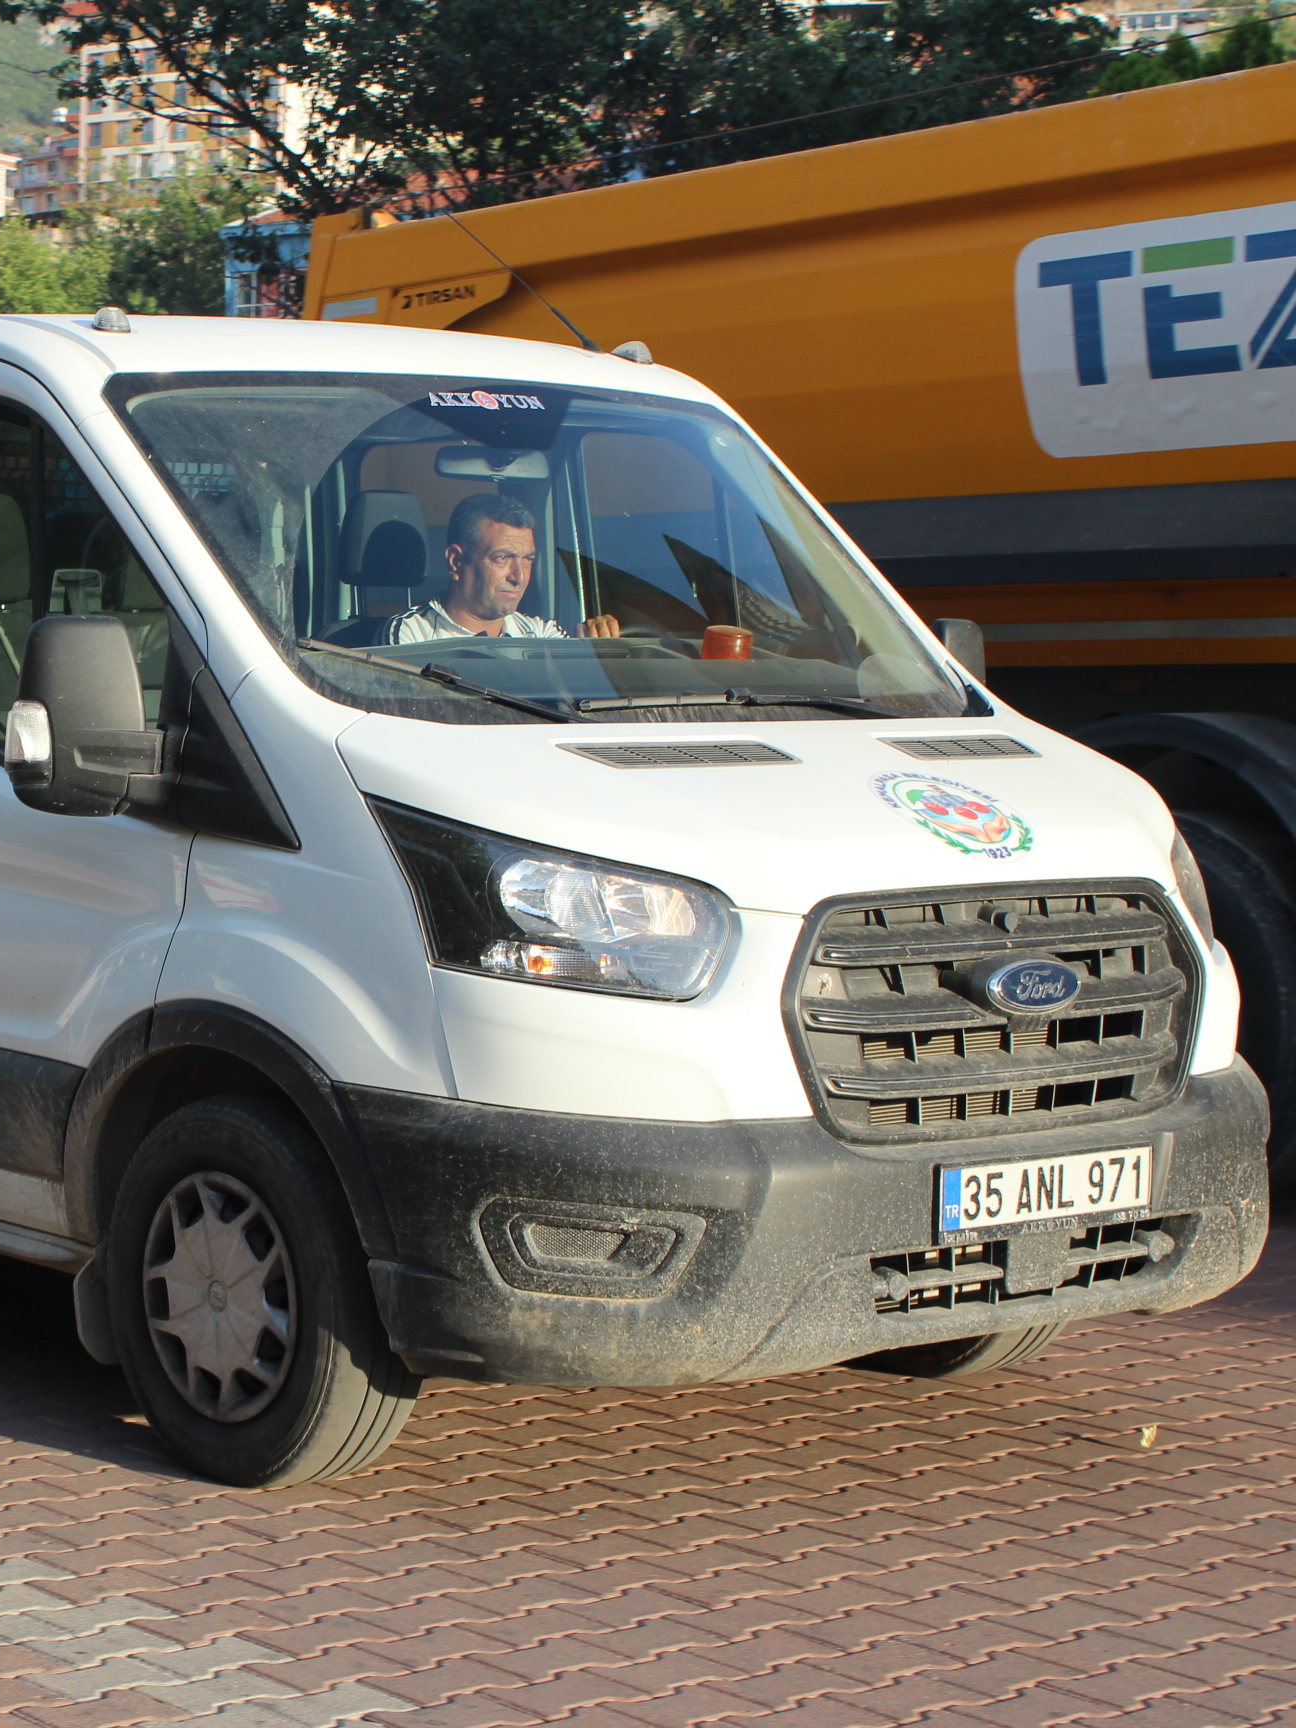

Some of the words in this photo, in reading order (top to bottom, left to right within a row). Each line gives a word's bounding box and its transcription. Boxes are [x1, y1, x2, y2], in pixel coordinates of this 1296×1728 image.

[415, 284, 476, 307] TIRSAN
[982, 846, 1012, 860] 1923
[1016, 969, 1066, 1001] Ford
[963, 1171, 1003, 1221] 35
[1016, 1164, 1074, 1214] ANL
[1088, 1155, 1141, 1205] 971
[945, 1204, 959, 1219] TR
